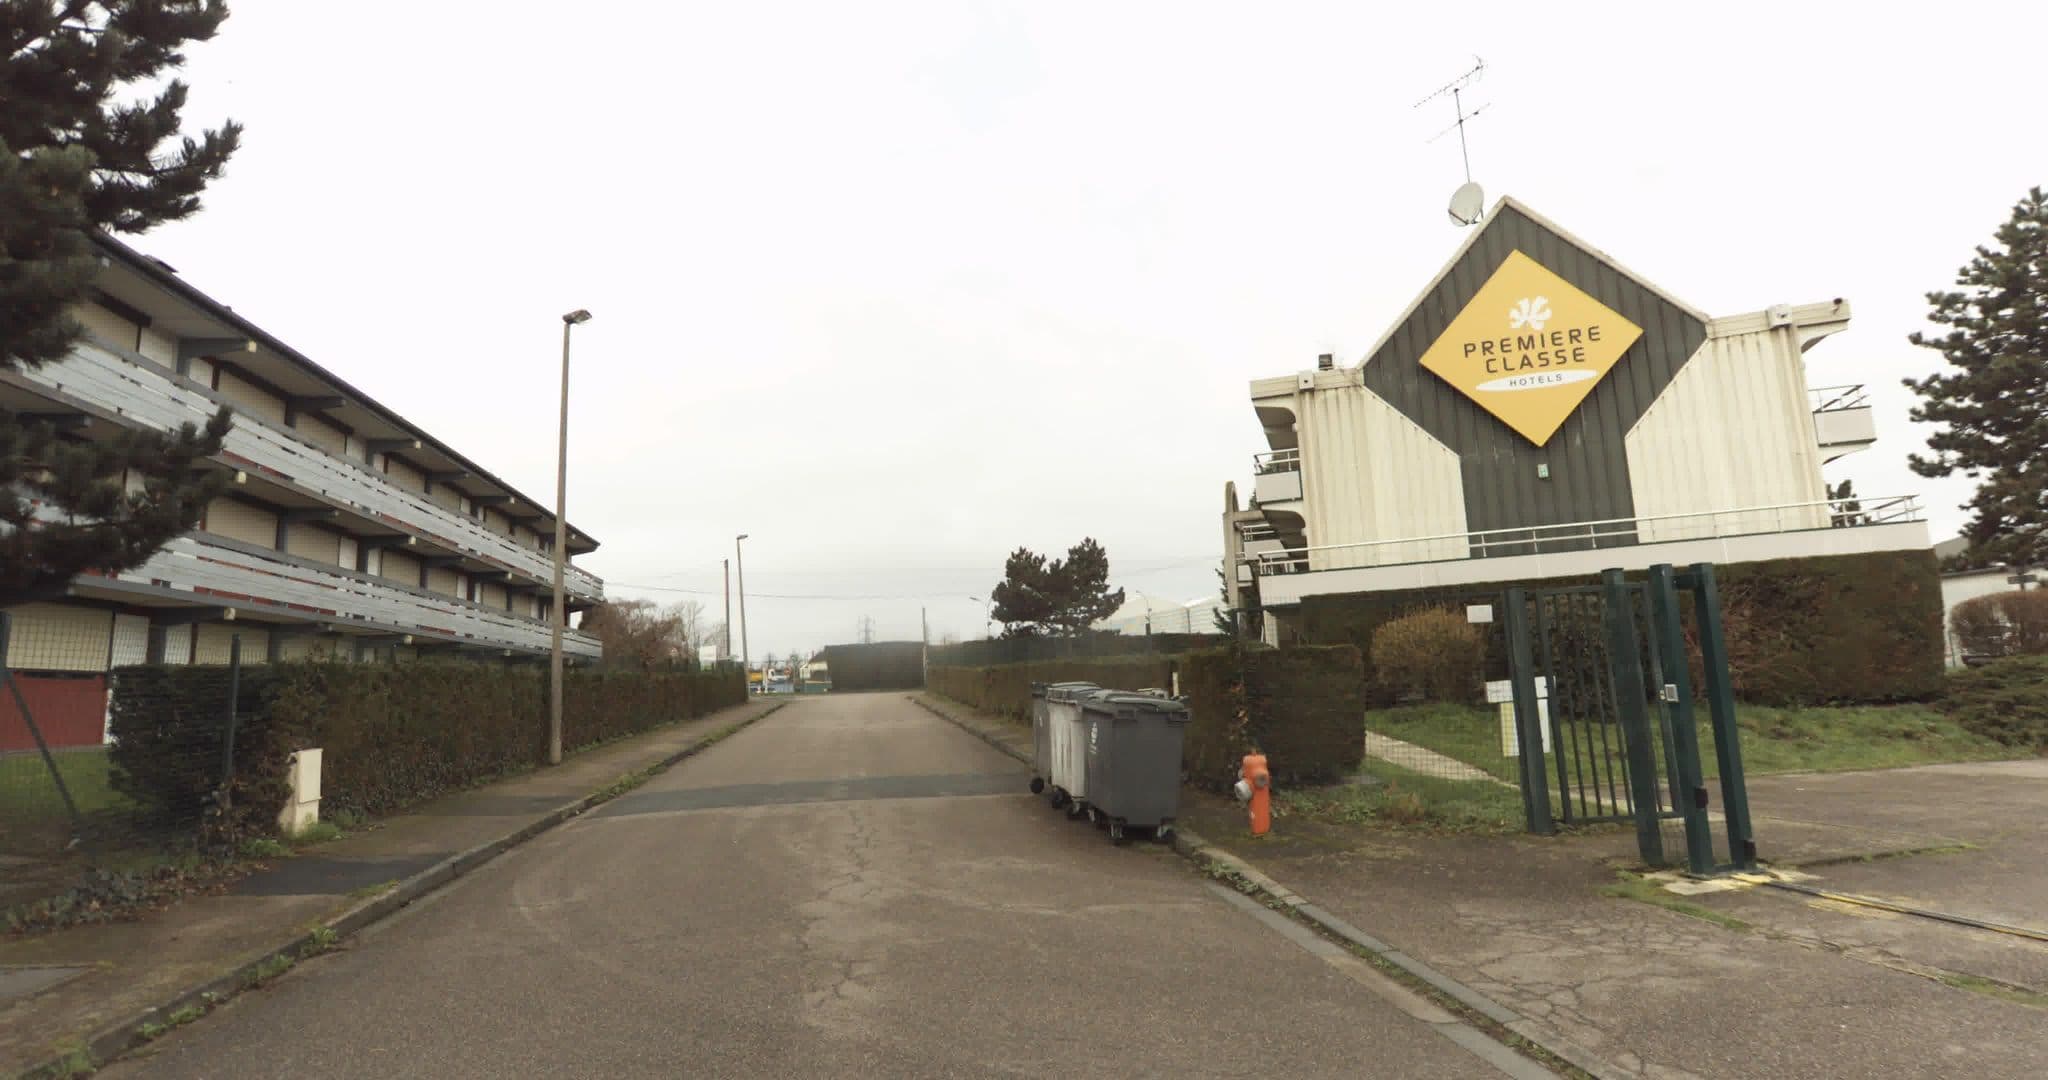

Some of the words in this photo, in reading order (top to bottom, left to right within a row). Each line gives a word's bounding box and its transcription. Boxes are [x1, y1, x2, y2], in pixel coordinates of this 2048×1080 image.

[1464, 326, 1601, 358] PREMIERE
[1486, 347, 1585, 373] CLASSE
[1509, 374, 1563, 387] HOTELS
